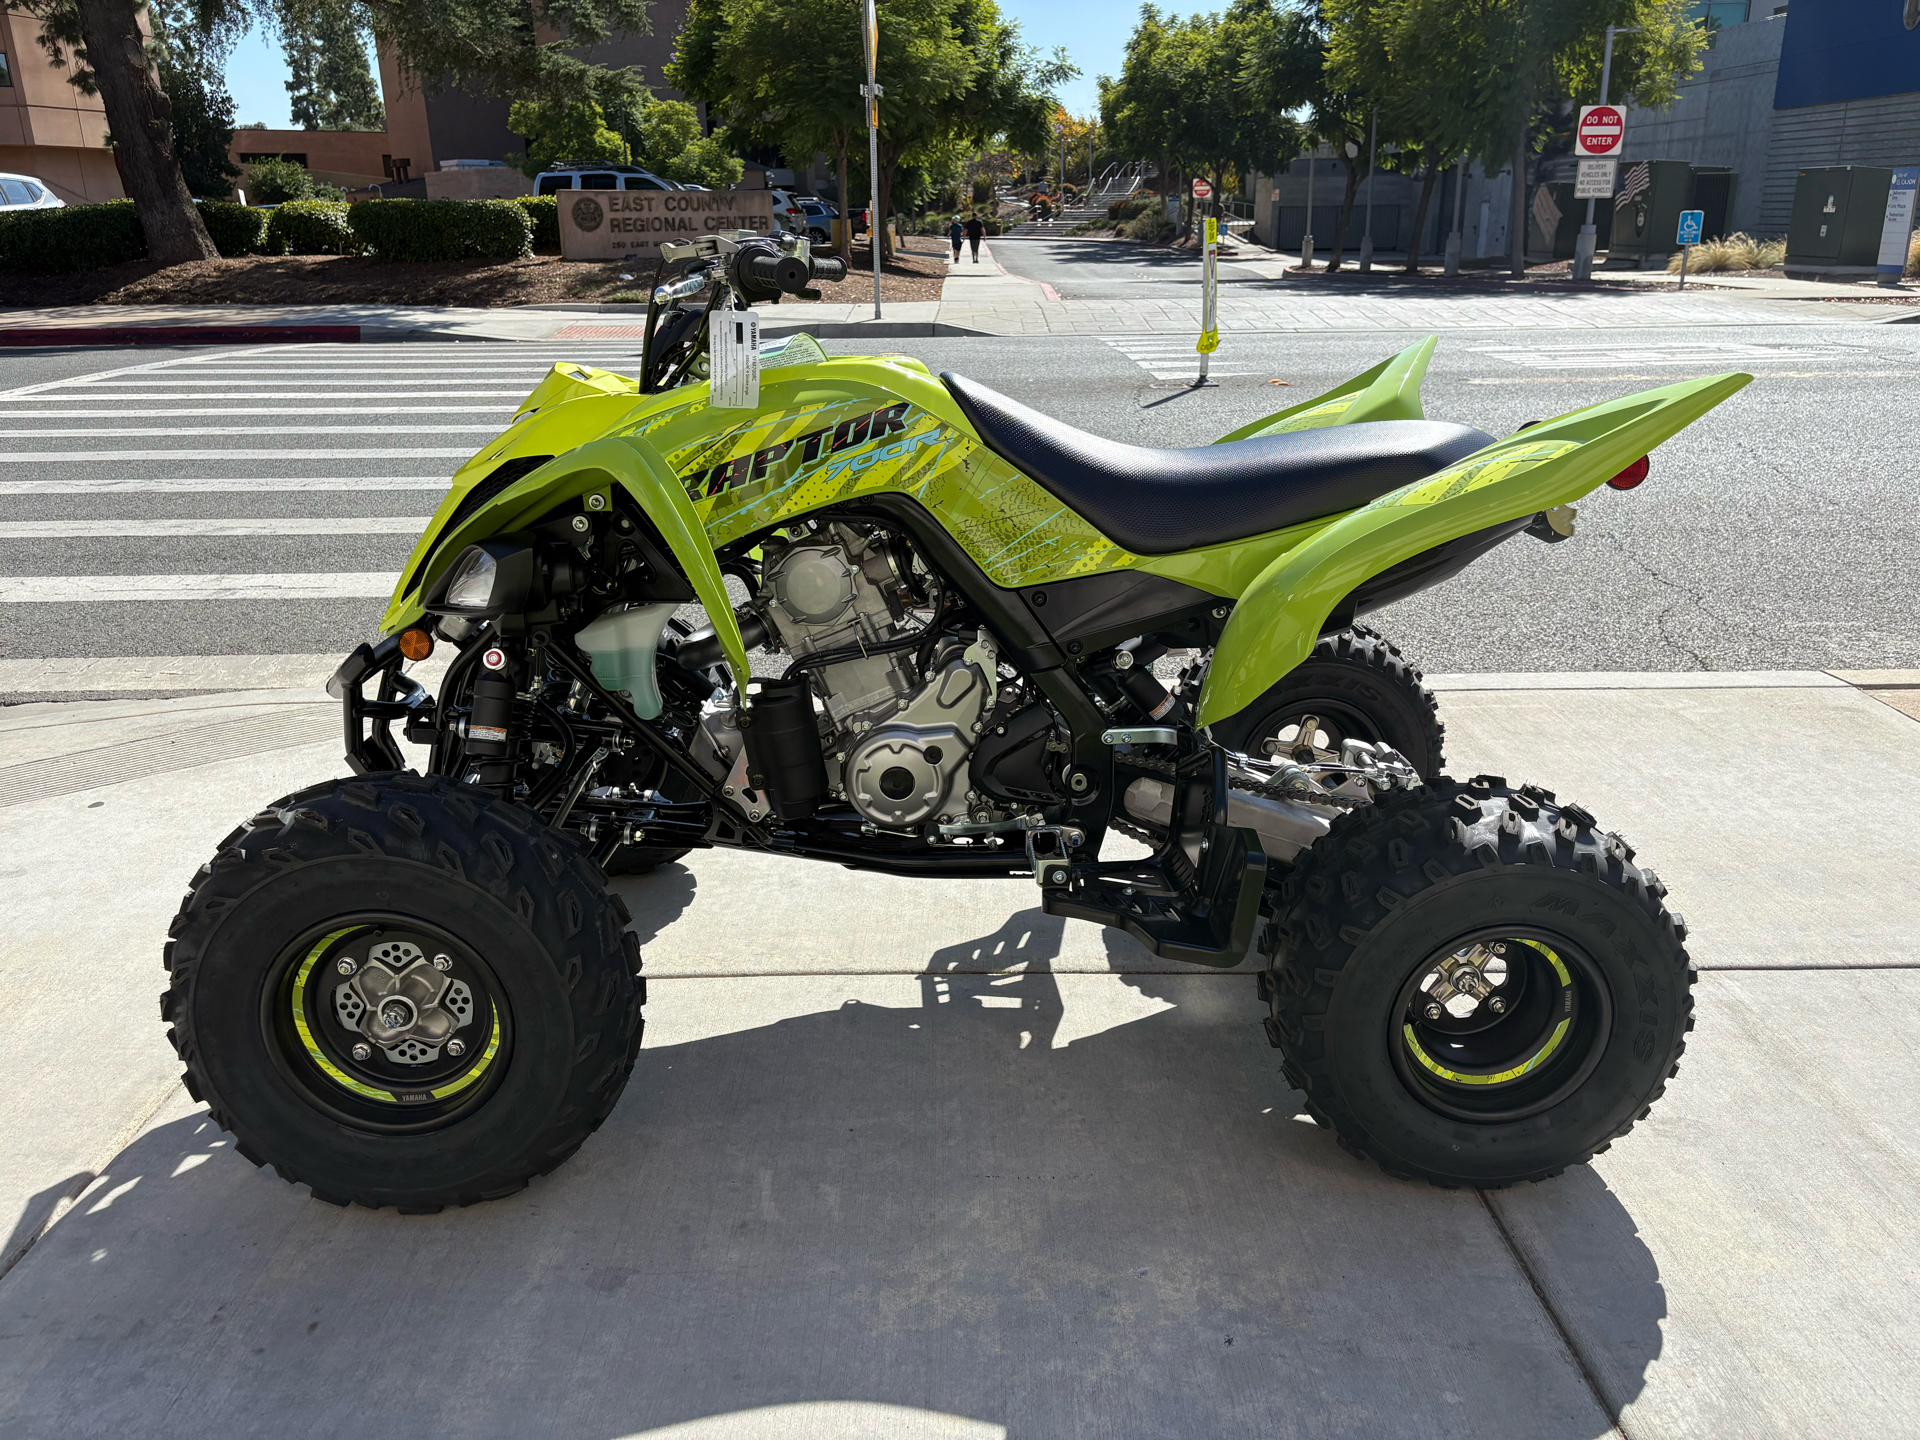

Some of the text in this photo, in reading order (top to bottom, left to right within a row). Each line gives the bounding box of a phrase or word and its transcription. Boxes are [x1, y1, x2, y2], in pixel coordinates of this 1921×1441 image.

[1586, 115, 1618, 124] DO NOT
[1586, 137, 1613, 145] ENTER
[608, 196, 736, 212] EAST COUNTY
[610, 215, 770, 233] REGIONAL CENTER
[823, 428, 941, 483] 700R
[1530, 893, 1661, 1064] MAXXIS
[1564, 990, 1572, 1012] YAMAHA
[402, 1094, 427, 1102] YAMAHA
